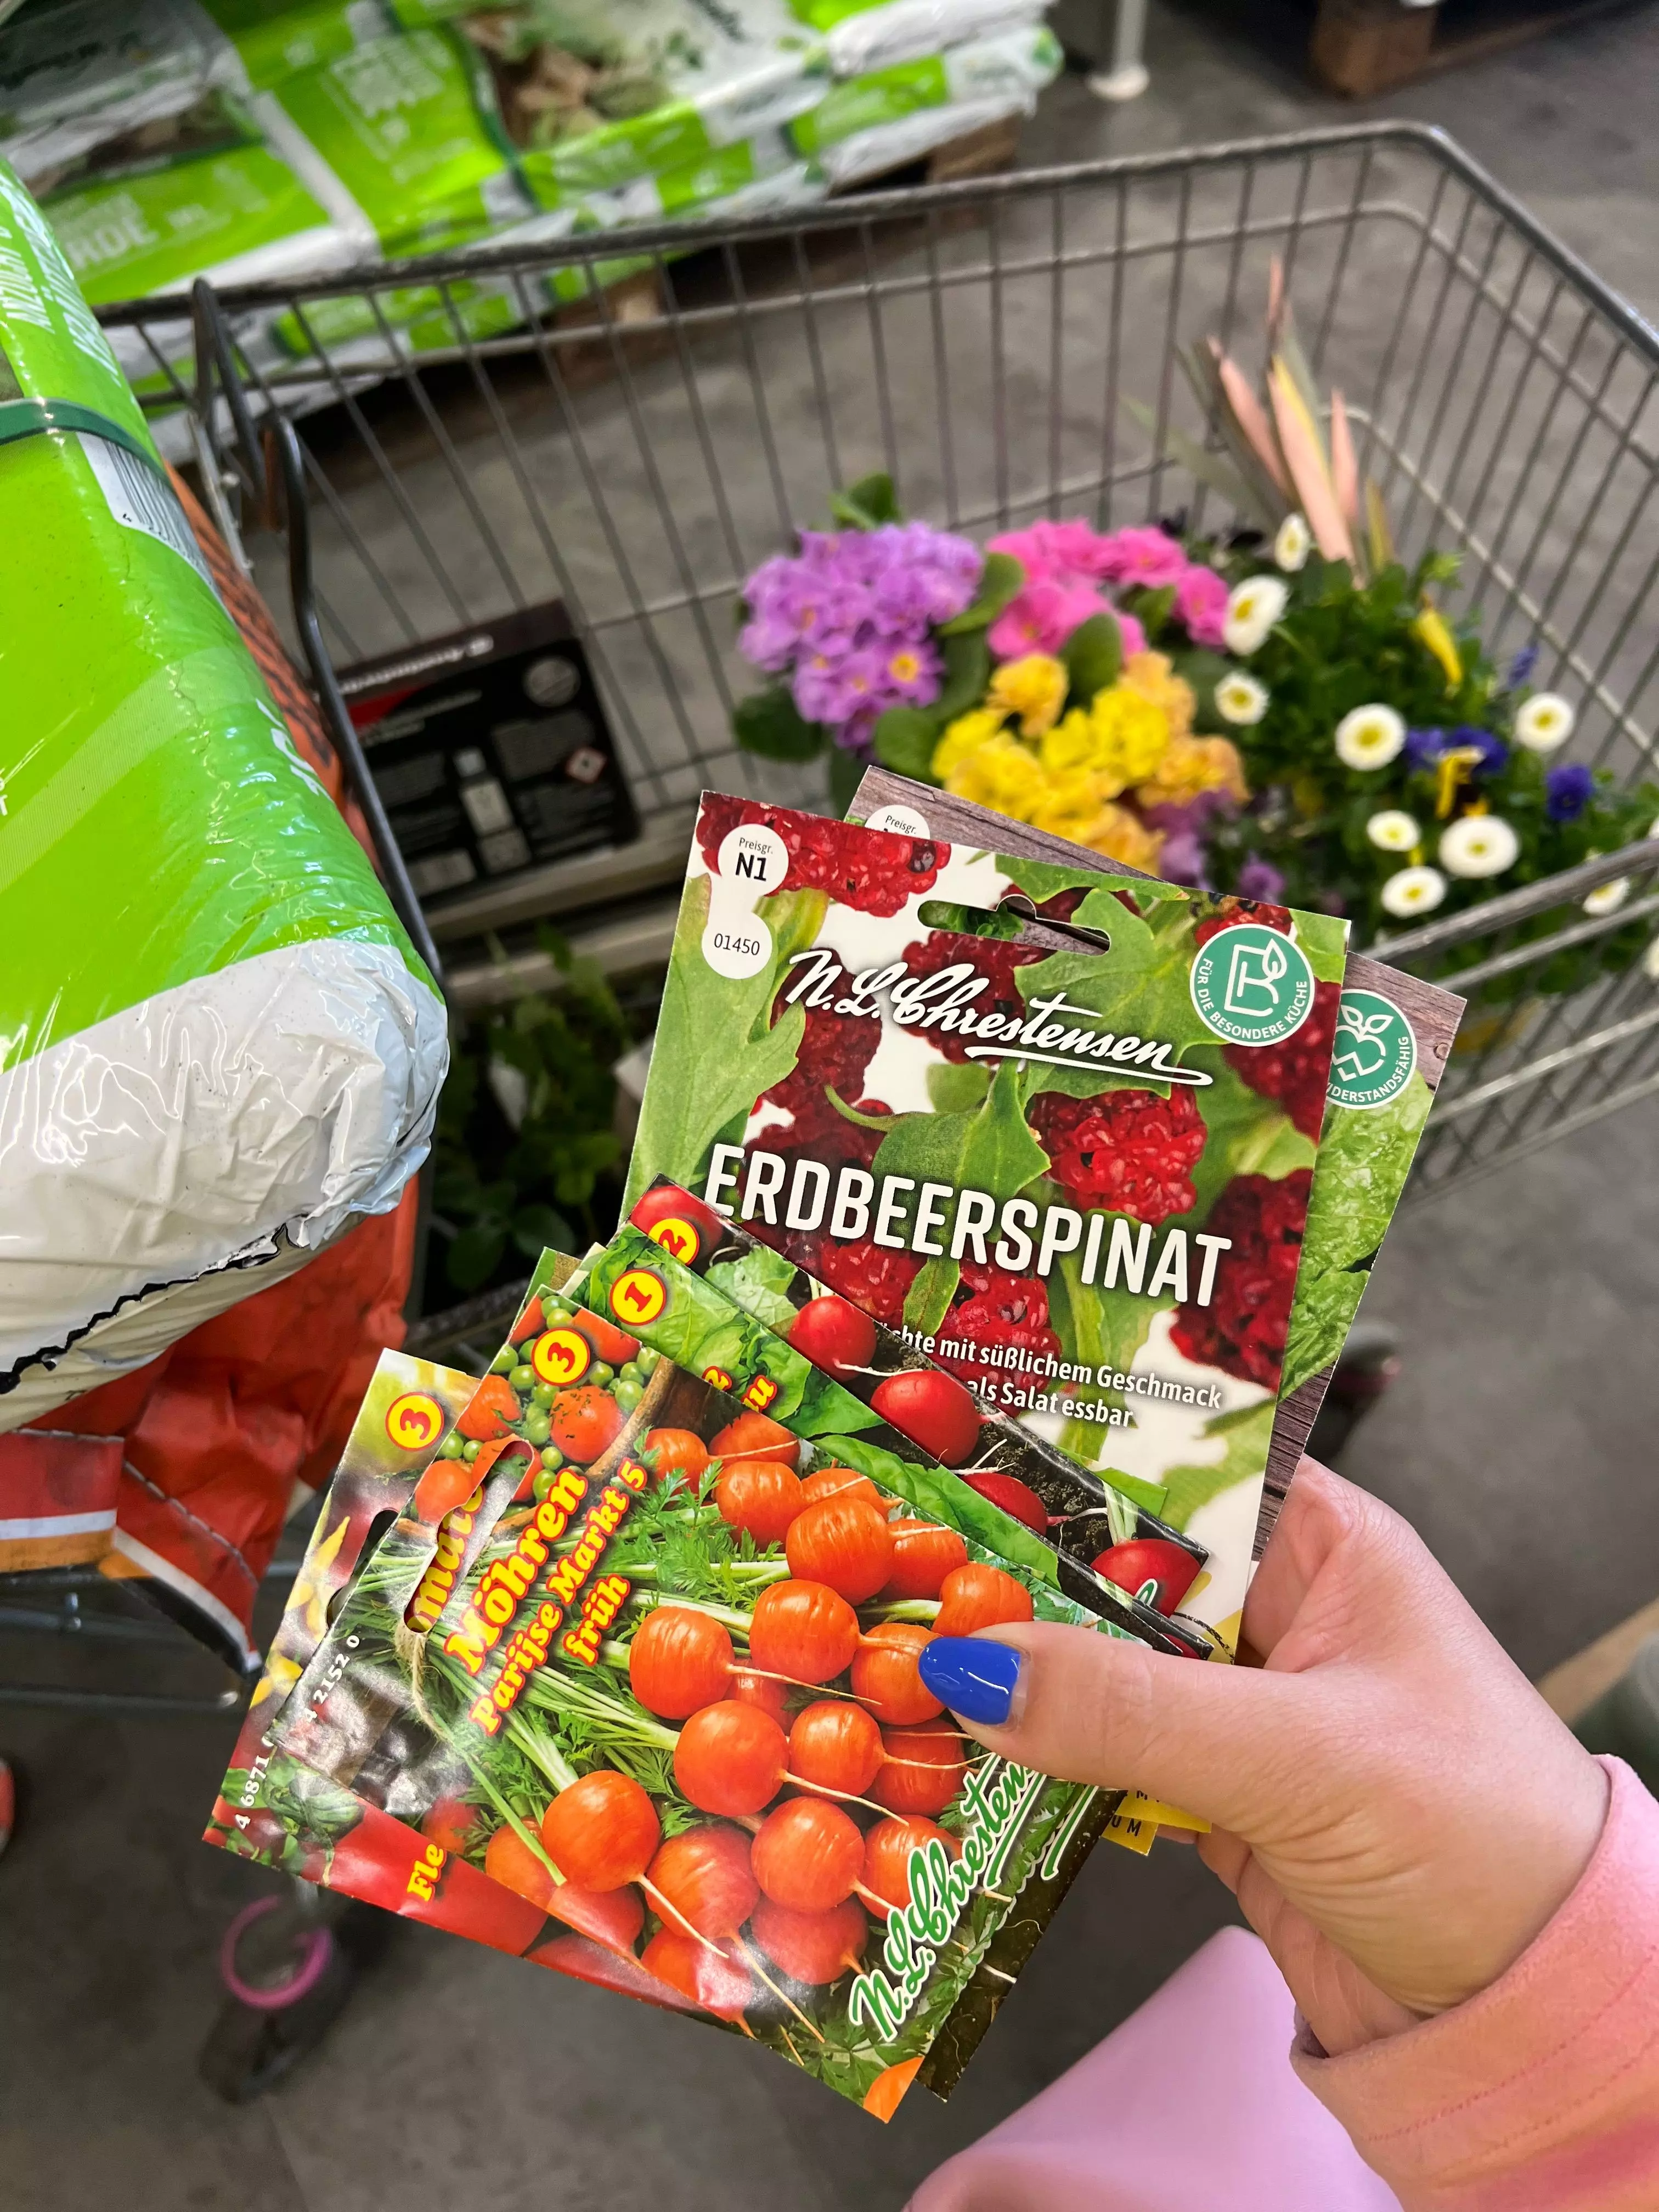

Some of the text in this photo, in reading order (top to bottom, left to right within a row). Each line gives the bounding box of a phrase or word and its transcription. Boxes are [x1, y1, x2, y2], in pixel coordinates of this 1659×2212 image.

[738, 837, 774, 855] Preisgr.
[885, 815, 917, 834] Preisgr.
[735, 852, 767, 882] N1
[713, 933, 761, 956] 01450
[1197, 957, 1308, 1041] FÜR DIE BESONDERE KÜCHE
[1327, 1036, 1410, 1103] IDERSTANDSFÄHIG
[704, 1142, 1233, 1307] ERDBEERSPINAT
[624, 1281, 653, 1312] 1
[548, 1342, 576, 1373] 3
[939, 1338, 977, 1362] mit
[979, 1344, 1092, 1384] süßlichem
[1097, 1364, 1222, 1409] Geschmack
[400, 1408, 432, 1441] 3
[1000, 1382, 1058, 1414] Salat
[1062, 1398, 1133, 1427] essbar
[444, 1469, 588, 1675] Möhren
[469, 1458, 647, 1736] Parijse Markt 5
[563, 1575, 630, 1666] früh
[313, 1653, 351, 1705] 2152
[240, 1755, 272, 1808] 6871
[234, 1813, 252, 1831] 4
[407, 1843, 447, 1901] Fle
